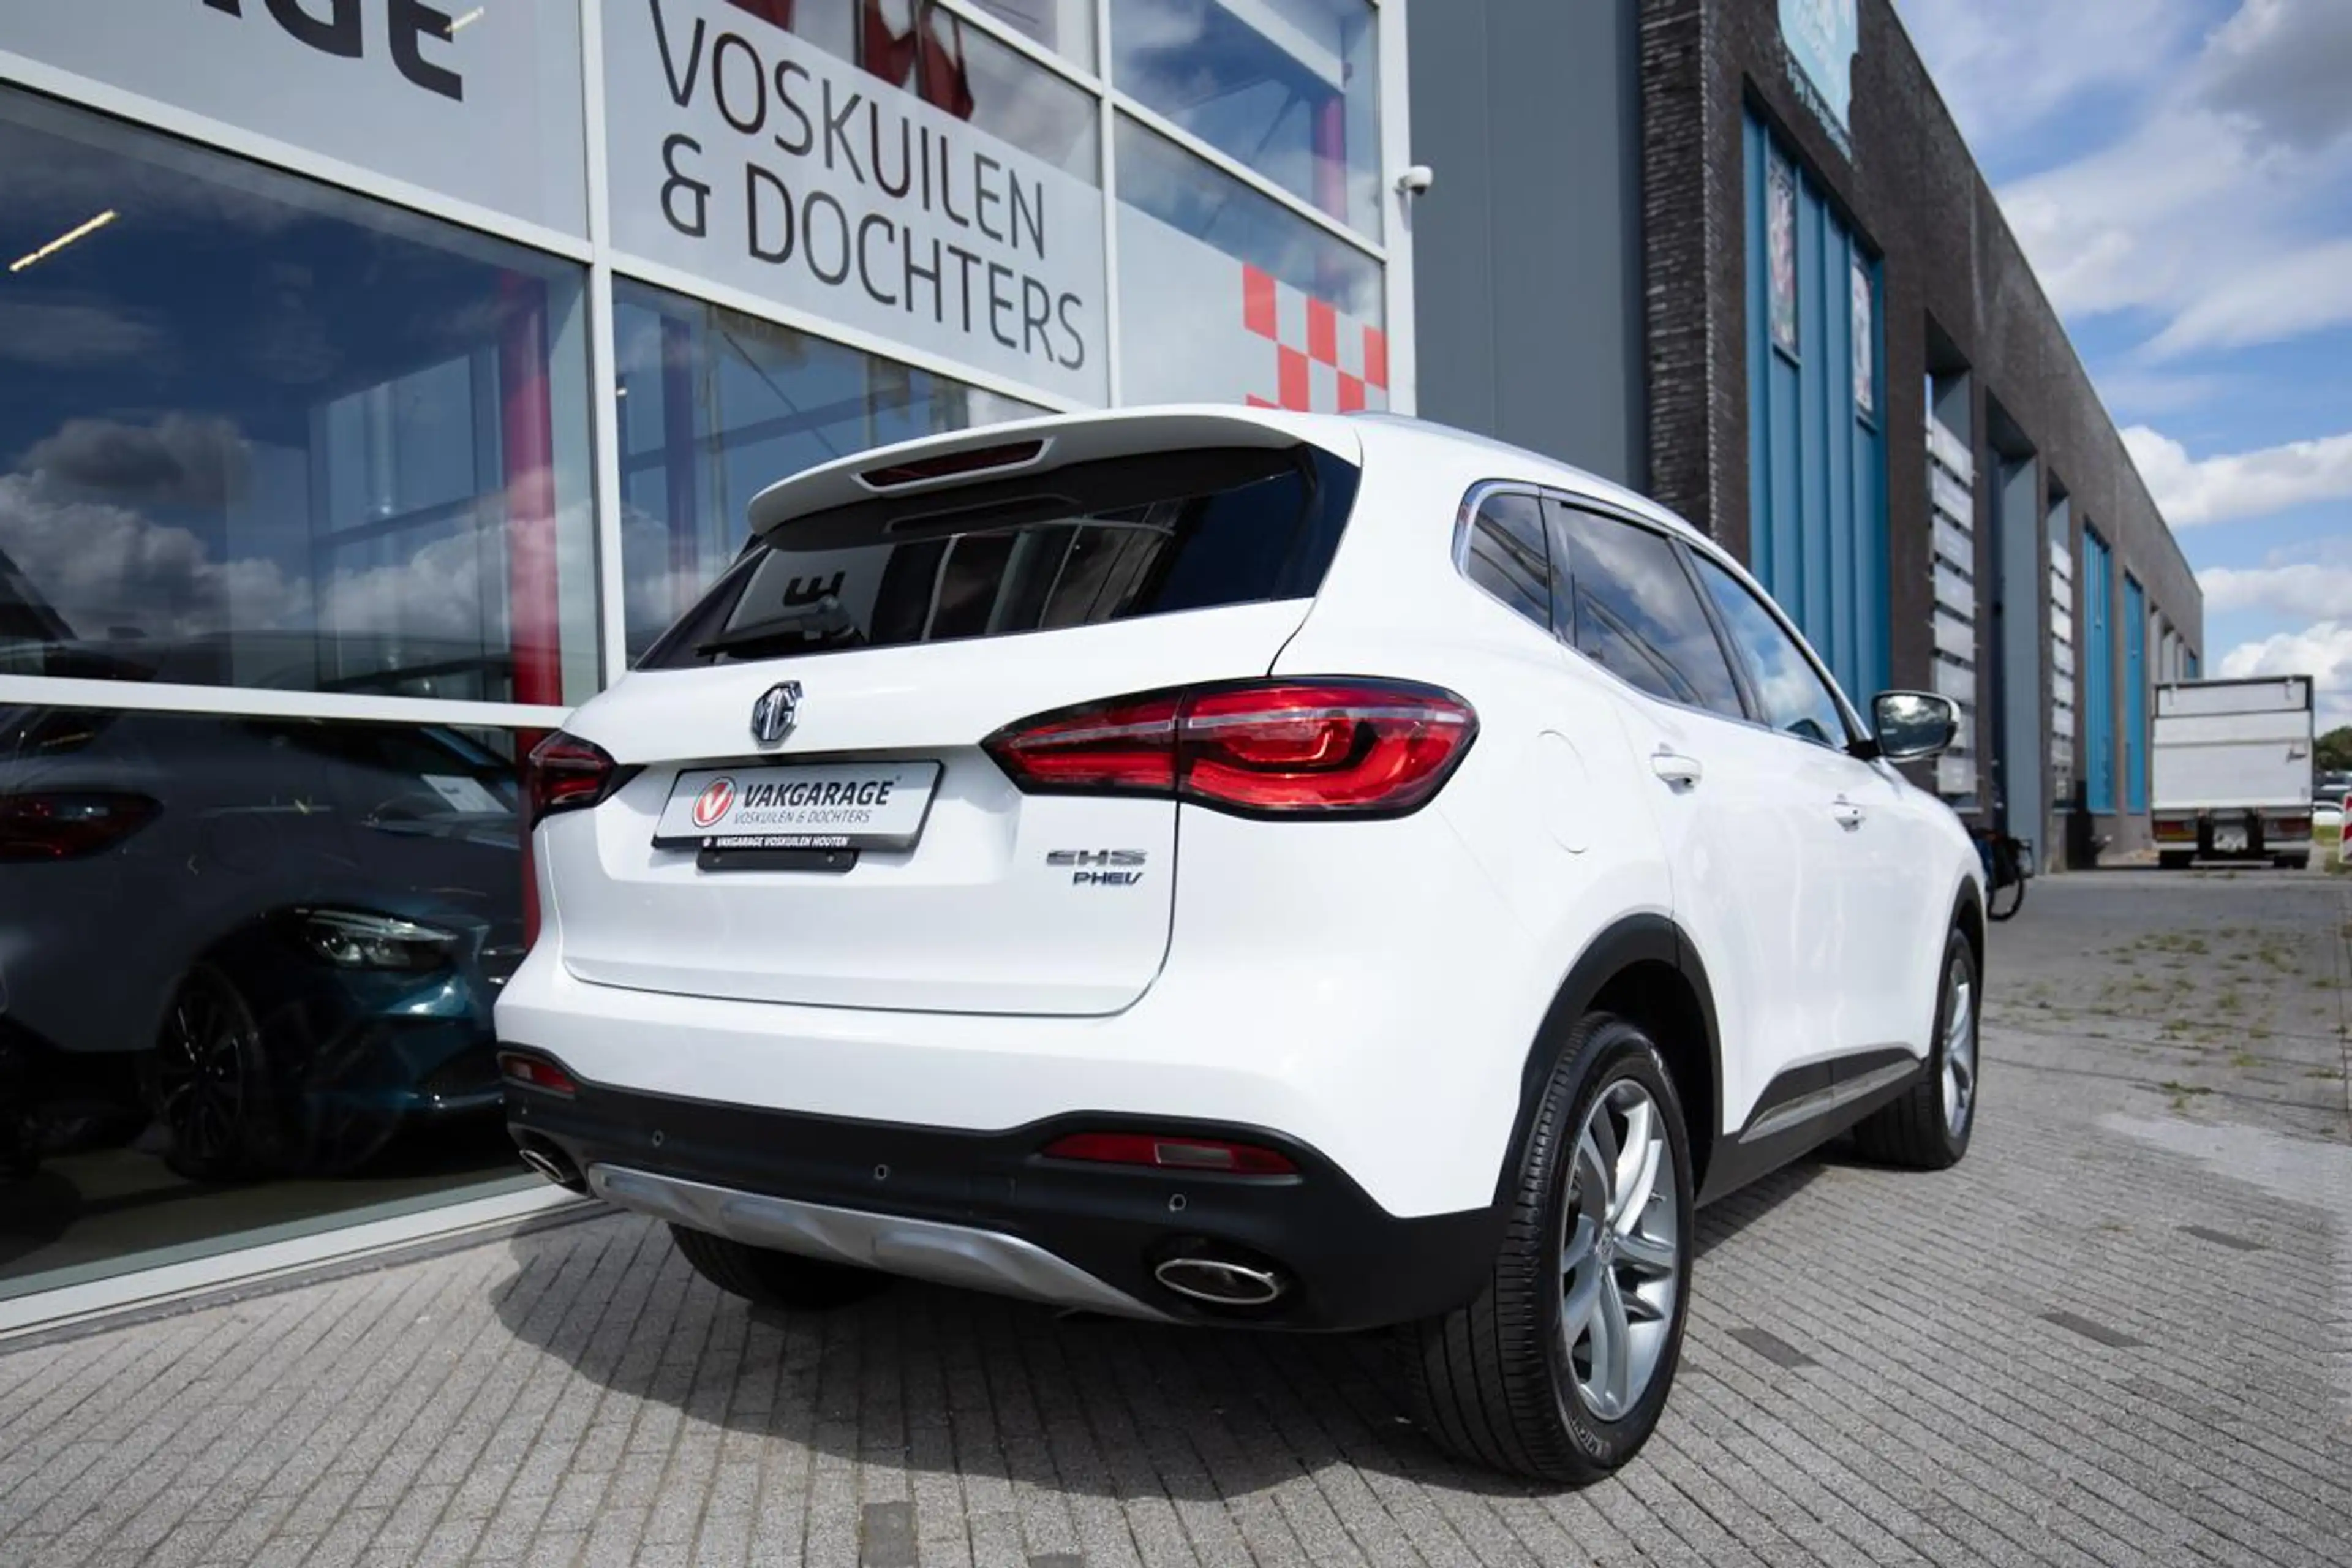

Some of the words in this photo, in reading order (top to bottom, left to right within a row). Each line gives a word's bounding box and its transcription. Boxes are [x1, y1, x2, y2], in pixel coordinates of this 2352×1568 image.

[649, 0, 1044, 260] VOSKUILEN
[660, 133, 711, 238] &
[746, 162, 1085, 371] DOCHTERS
[743, 781, 894, 808] VAKGARAGE
[734, 812, 796, 824] VOSKUILEN
[807, 809, 870, 824] DOCHTERS
[716, 837, 764, 847] VAKGARAGE
[764, 837, 811, 847] VOSKUILEN
[812, 836, 850, 846] HOUTEN
[1046, 848, 1147, 866] EHS
[1072, 871, 1144, 885] PHEV
